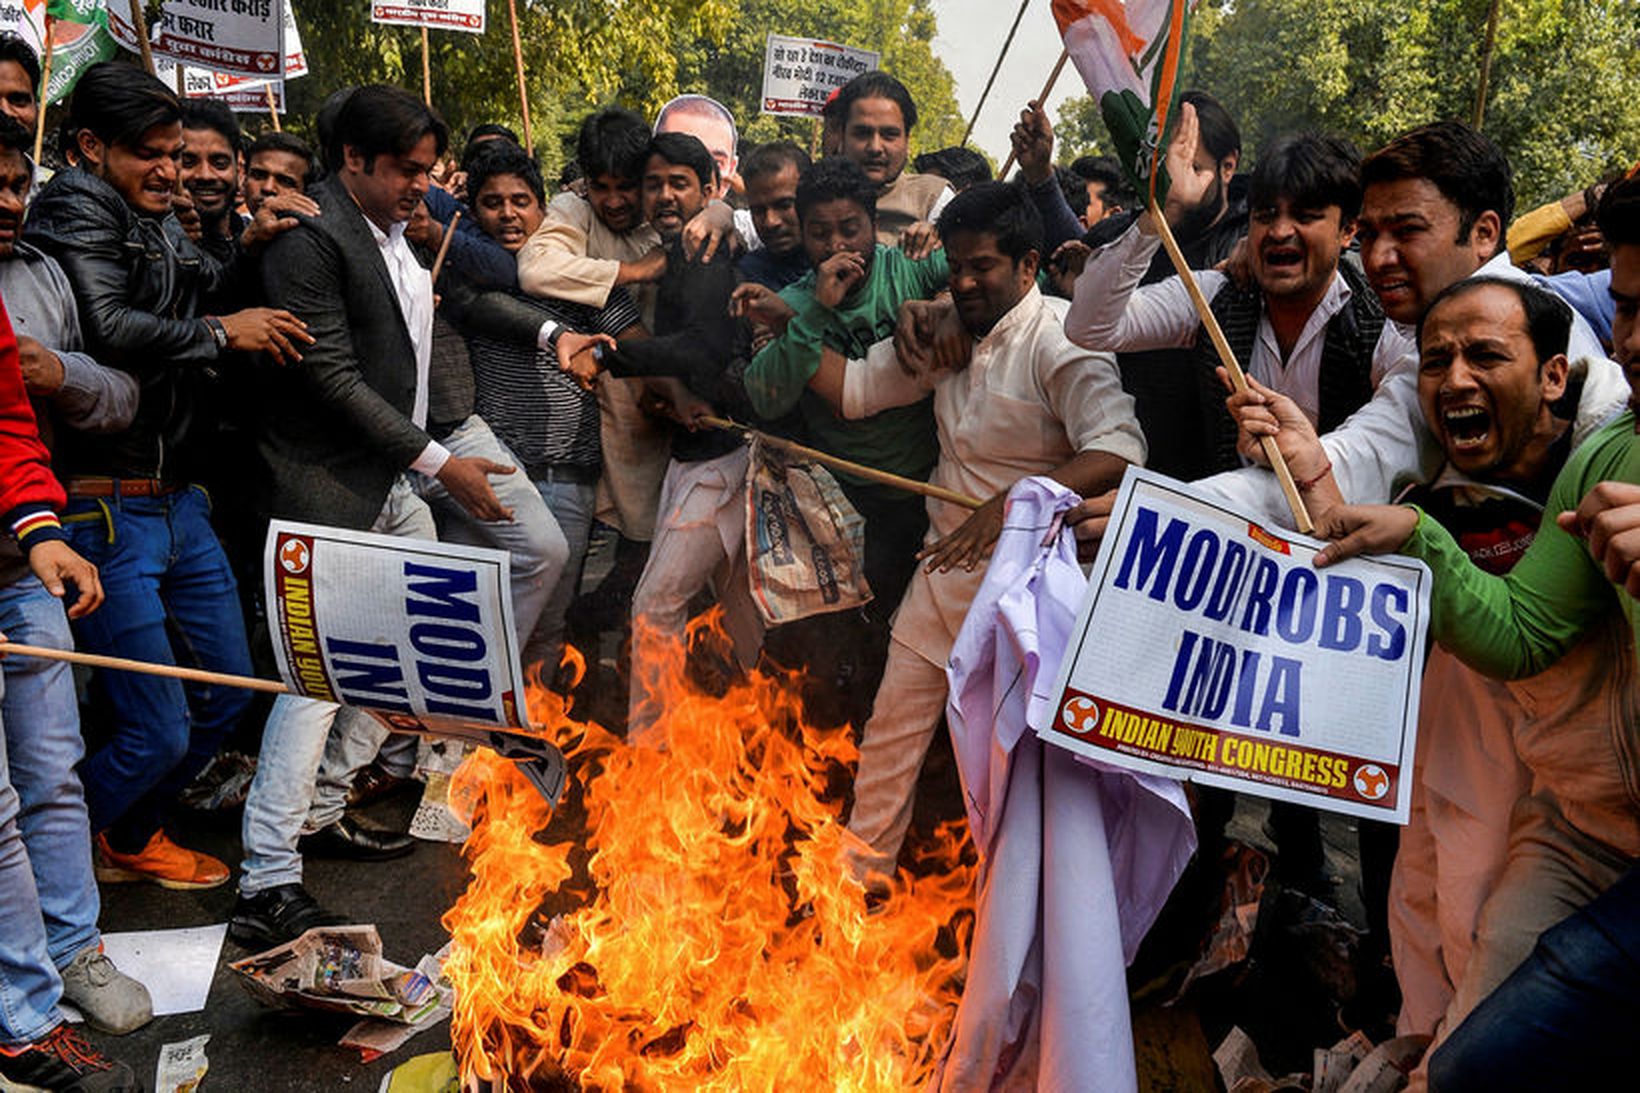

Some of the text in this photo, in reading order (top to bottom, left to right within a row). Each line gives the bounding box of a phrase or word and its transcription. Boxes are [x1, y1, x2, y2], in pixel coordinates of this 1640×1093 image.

[178, 15, 215, 41] फरार
[283, 576, 317, 654] INDIAN
[403, 561, 500, 723] MODI
[1239, 549, 1410, 662] ROBS
[1161, 630, 1303, 738] INDIA
[1099, 707, 1174, 754] INDIAN
[1221, 736, 1350, 789] CONGRESS
